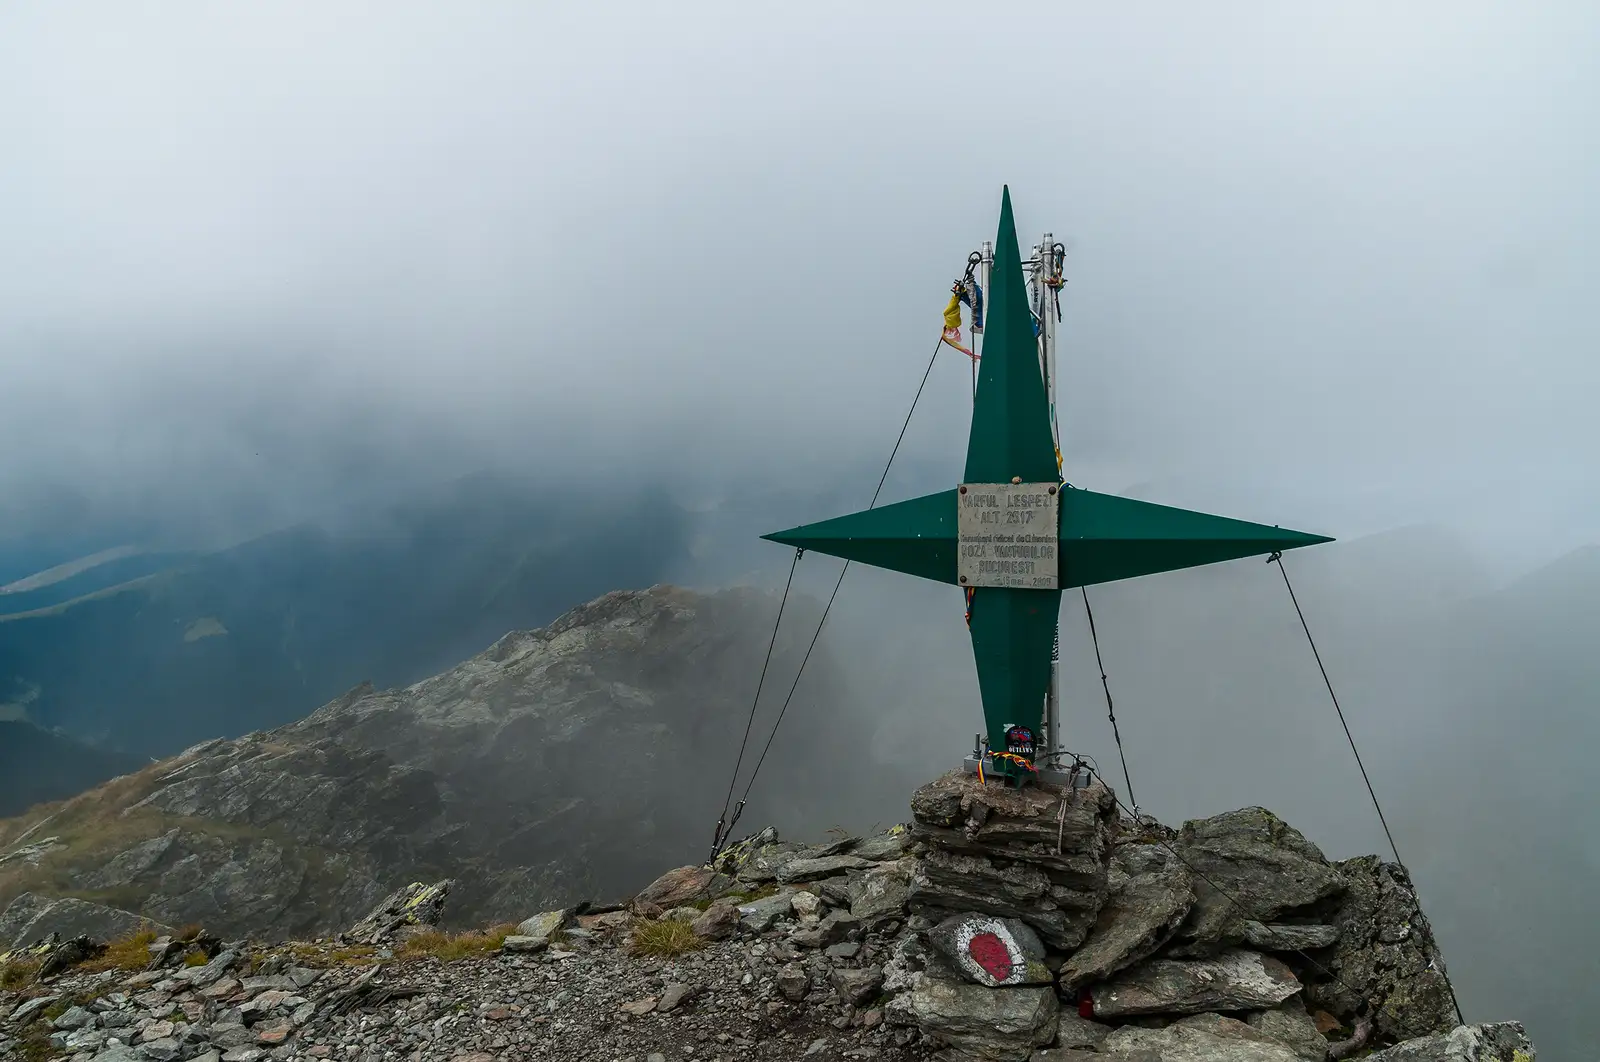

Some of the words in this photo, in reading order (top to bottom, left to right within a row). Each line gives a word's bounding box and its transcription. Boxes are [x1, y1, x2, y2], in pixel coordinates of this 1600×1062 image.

[1006, 494, 1053, 508] LESPEZI
[1006, 510, 1034, 524] 2517
[961, 545, 987, 558] ROZA
